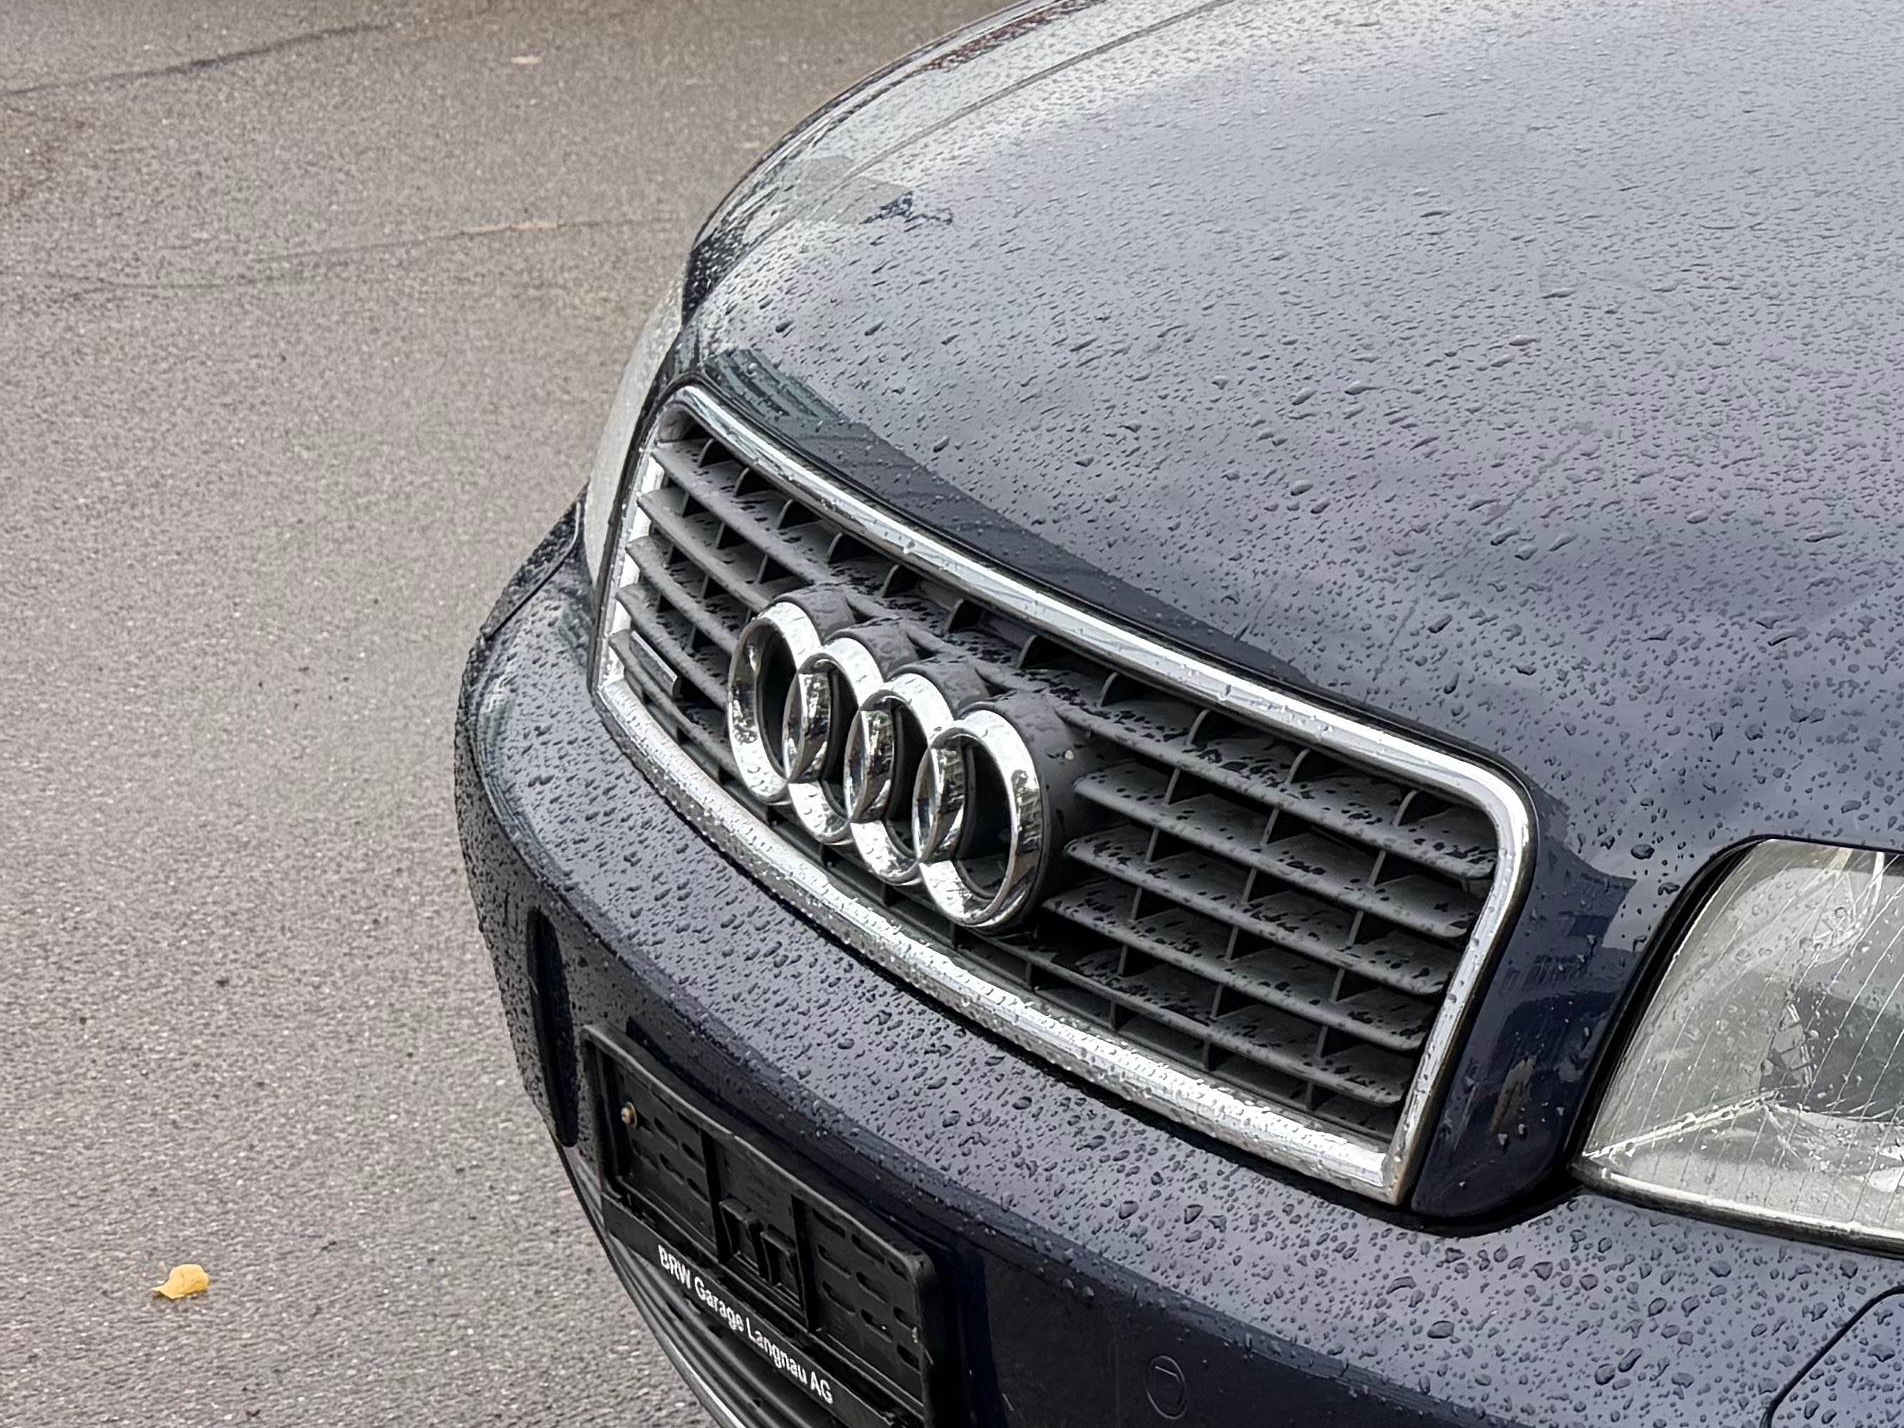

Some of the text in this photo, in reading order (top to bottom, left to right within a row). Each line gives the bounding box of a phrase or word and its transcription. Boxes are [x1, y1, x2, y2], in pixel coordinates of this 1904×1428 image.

[658, 1244, 833, 1404] BRW Garage Langnau AG
